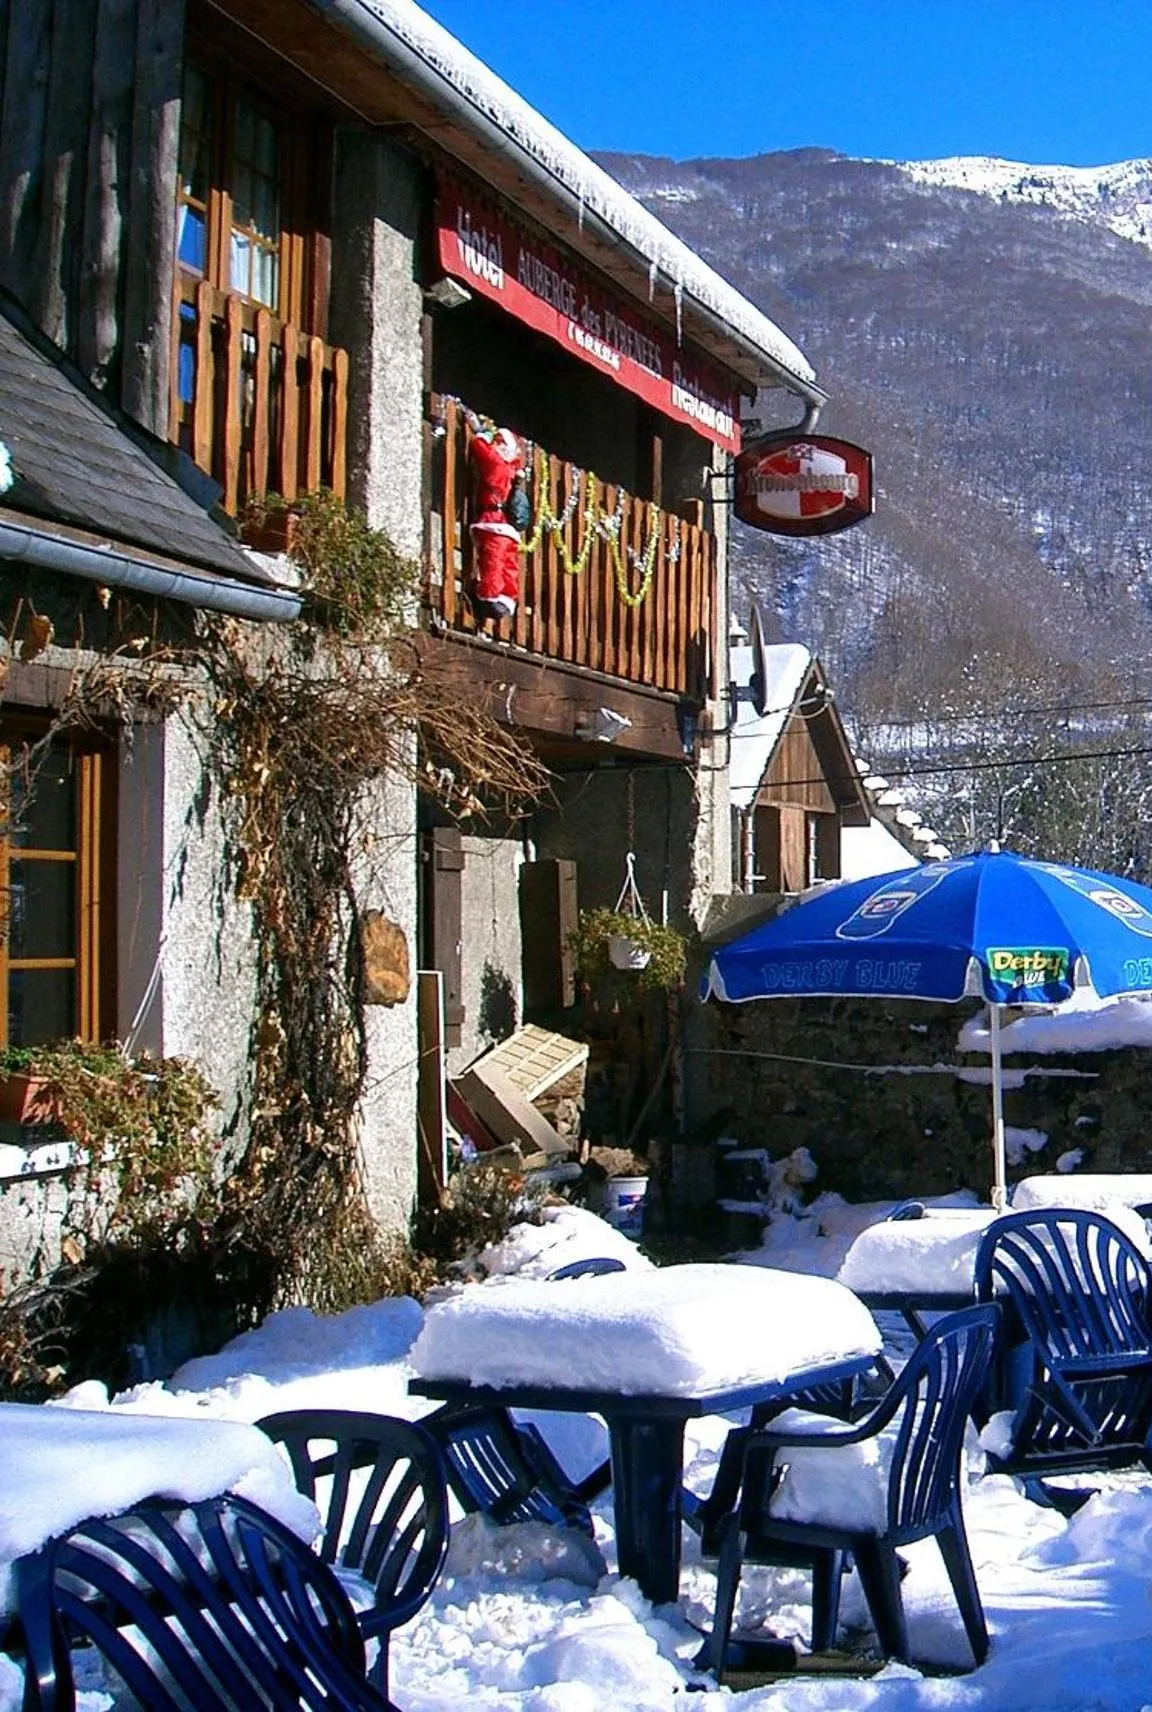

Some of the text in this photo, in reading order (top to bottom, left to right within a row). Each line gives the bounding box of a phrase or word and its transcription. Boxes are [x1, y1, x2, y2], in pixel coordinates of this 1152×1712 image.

[518, 248, 578, 320] AUBERGE
[580, 296, 601, 335] des
[761, 959, 922, 989] DERBY BLUE
[993, 951, 1061, 977] Derby
